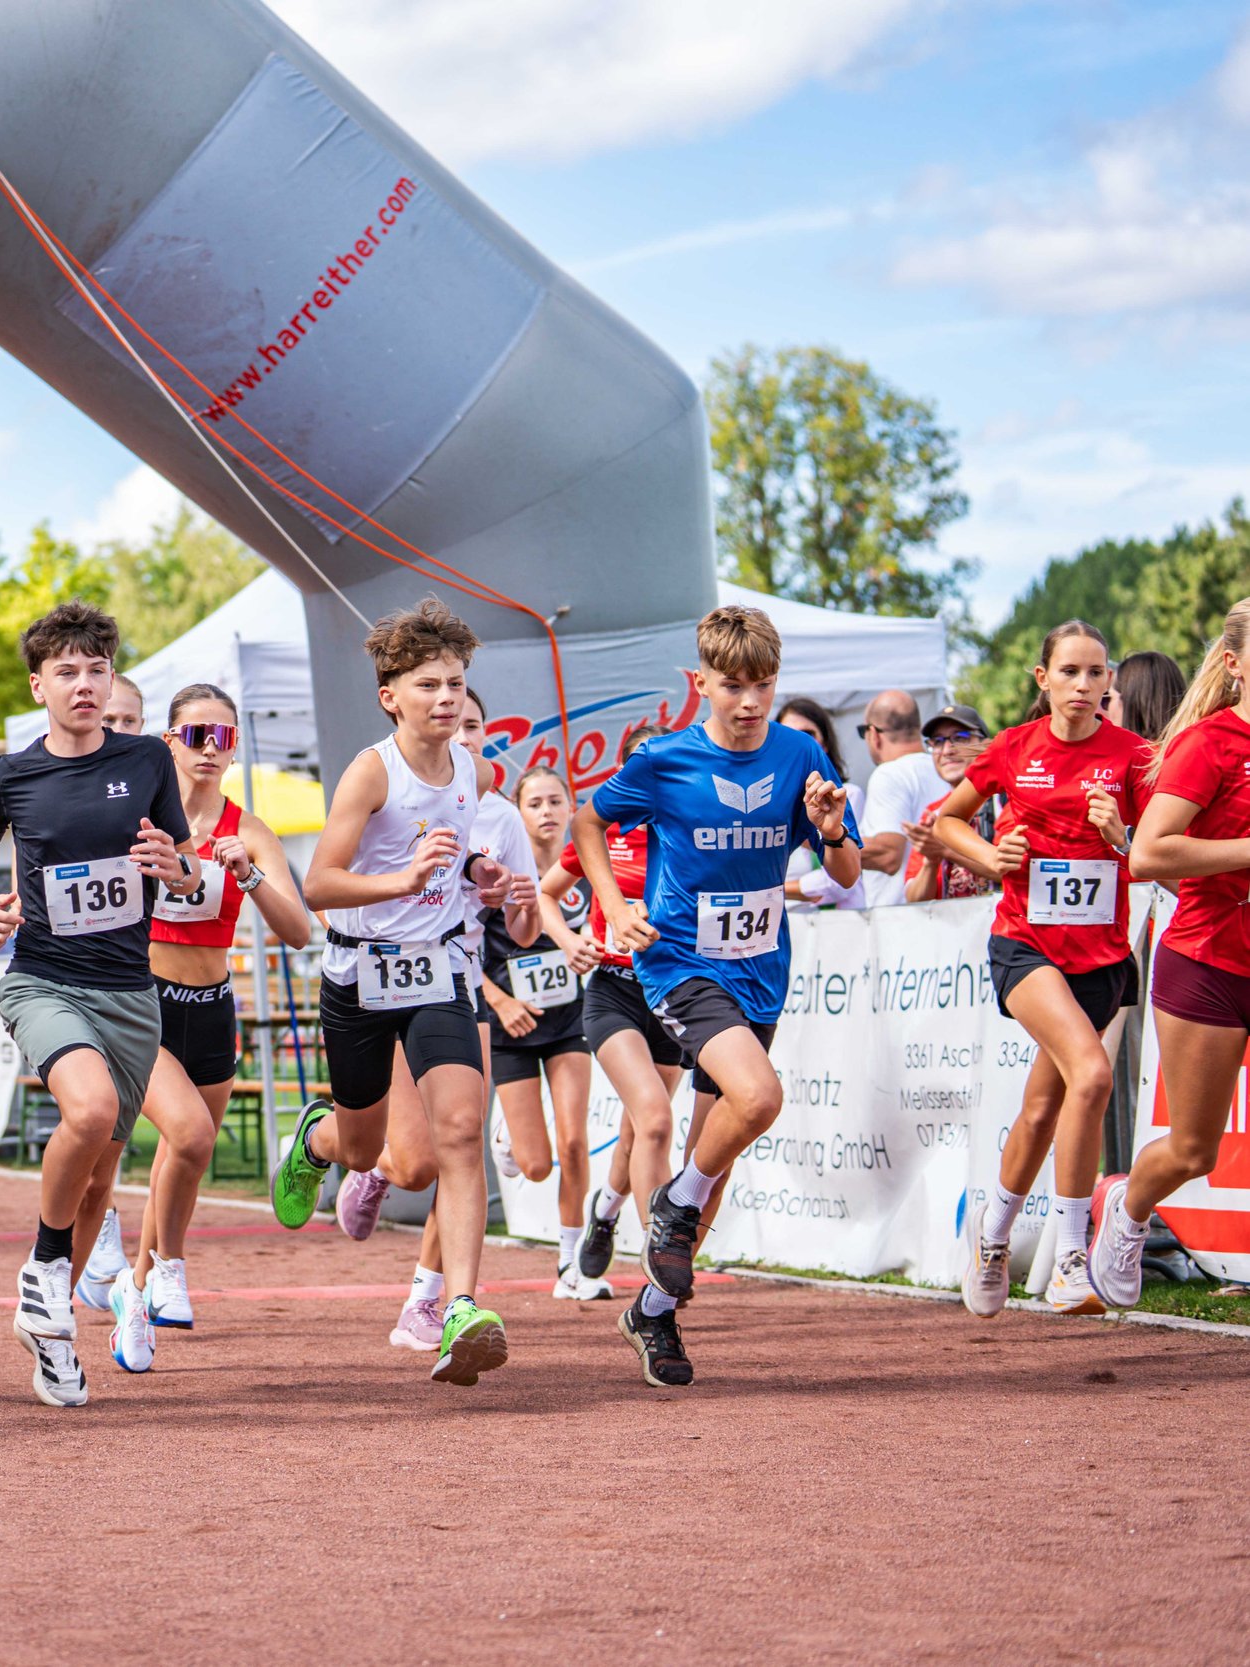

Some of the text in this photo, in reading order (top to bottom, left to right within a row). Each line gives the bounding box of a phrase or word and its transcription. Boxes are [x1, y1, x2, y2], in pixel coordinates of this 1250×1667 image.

[201, 175, 418, 422] www.harreither.com
[1080, 780, 1121, 792] Neuurth
[1093, 768, 1112, 780] LC
[693, 820, 788, 851] erima
[64, 876, 128, 915] 136
[1045, 877, 1102, 906] 137
[716, 907, 771, 942] 134
[374, 956, 434, 990] 133
[525, 964, 569, 993] 129
[162, 984, 216, 1003] NIKE
[905, 1043, 934, 1069] 3361
[589, 1096, 619, 1127] ATZ
[831, 1133, 892, 1170] GmbH
